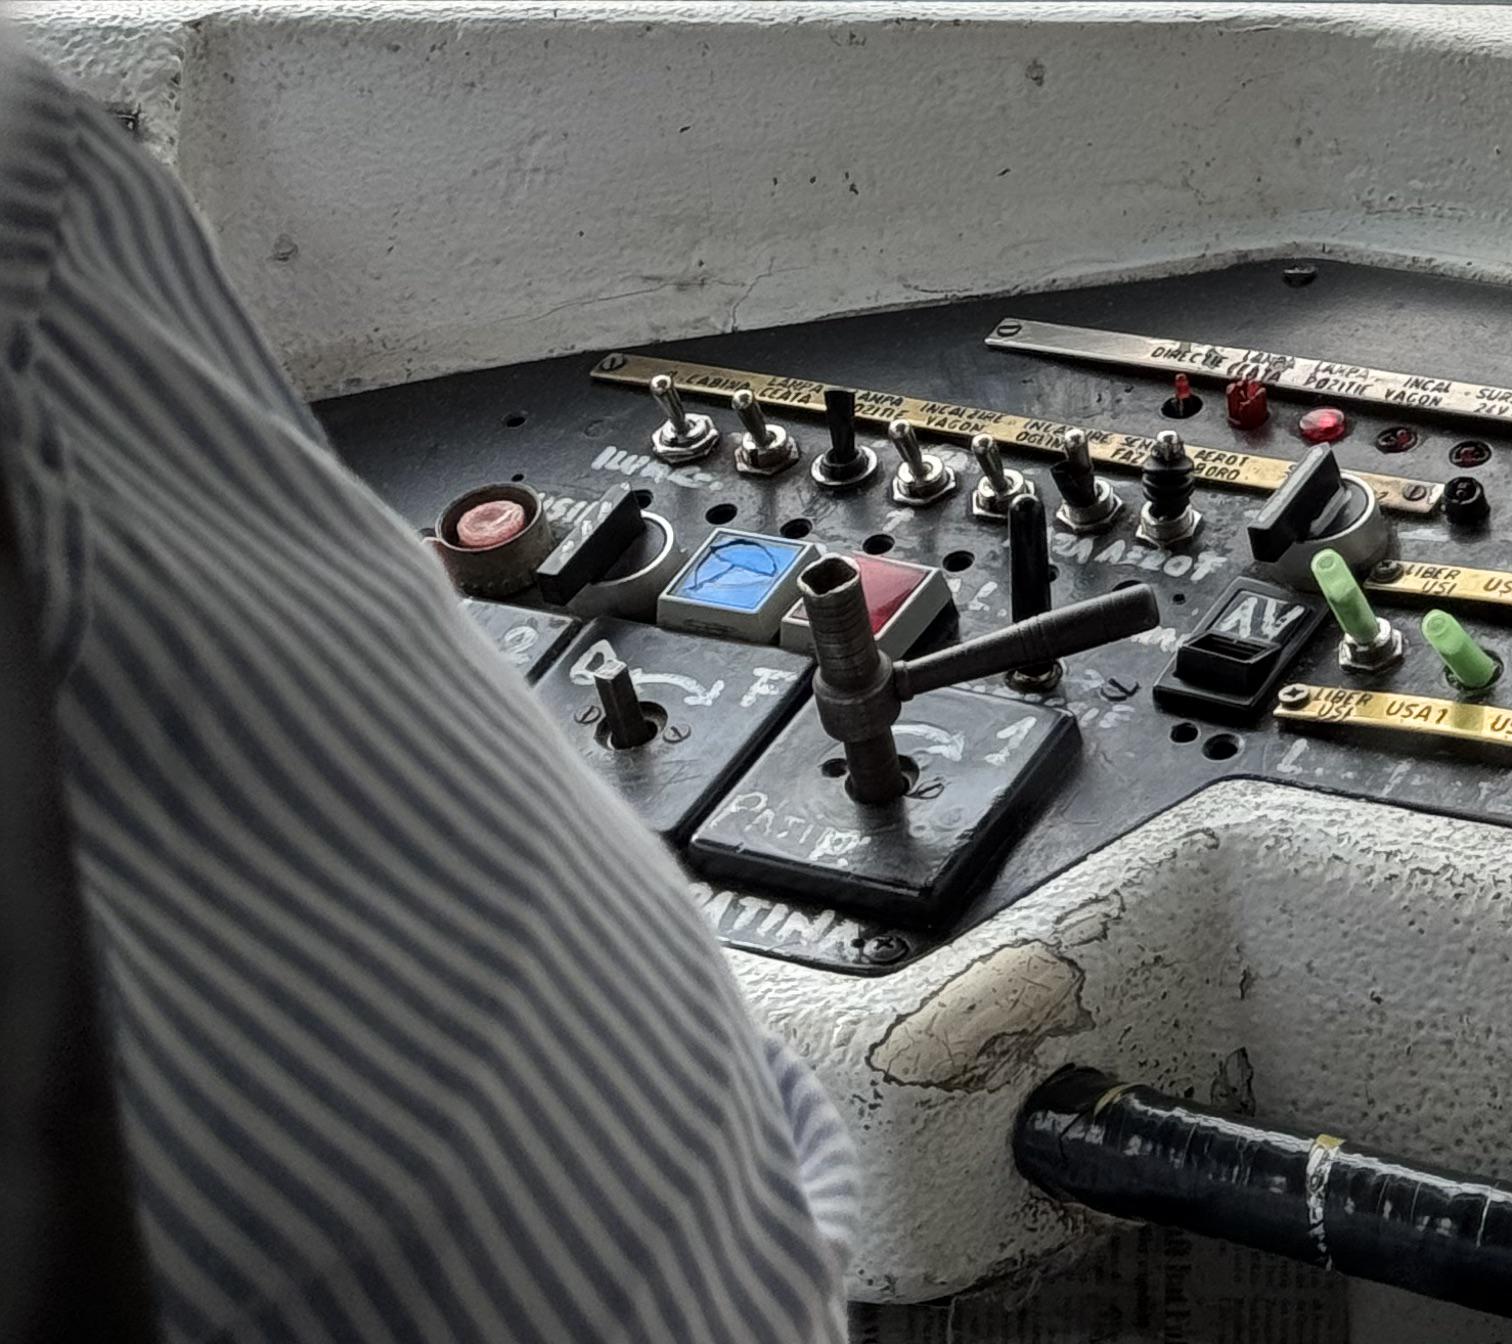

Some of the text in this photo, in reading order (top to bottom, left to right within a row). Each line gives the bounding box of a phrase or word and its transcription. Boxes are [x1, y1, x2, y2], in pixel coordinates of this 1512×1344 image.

[767, 377, 824, 394] LAMPA
[1402, 377, 1453, 394] INCAL
[855, 390, 903, 405] AMPA
[1384, 388, 1444, 408] VAGON
[854, 403, 909, 420] OZITIE
[926, 415, 986, 433] VAGON
[1405, 564, 1462, 581] LIBER
[1313, 687, 1374, 706] LIBER
